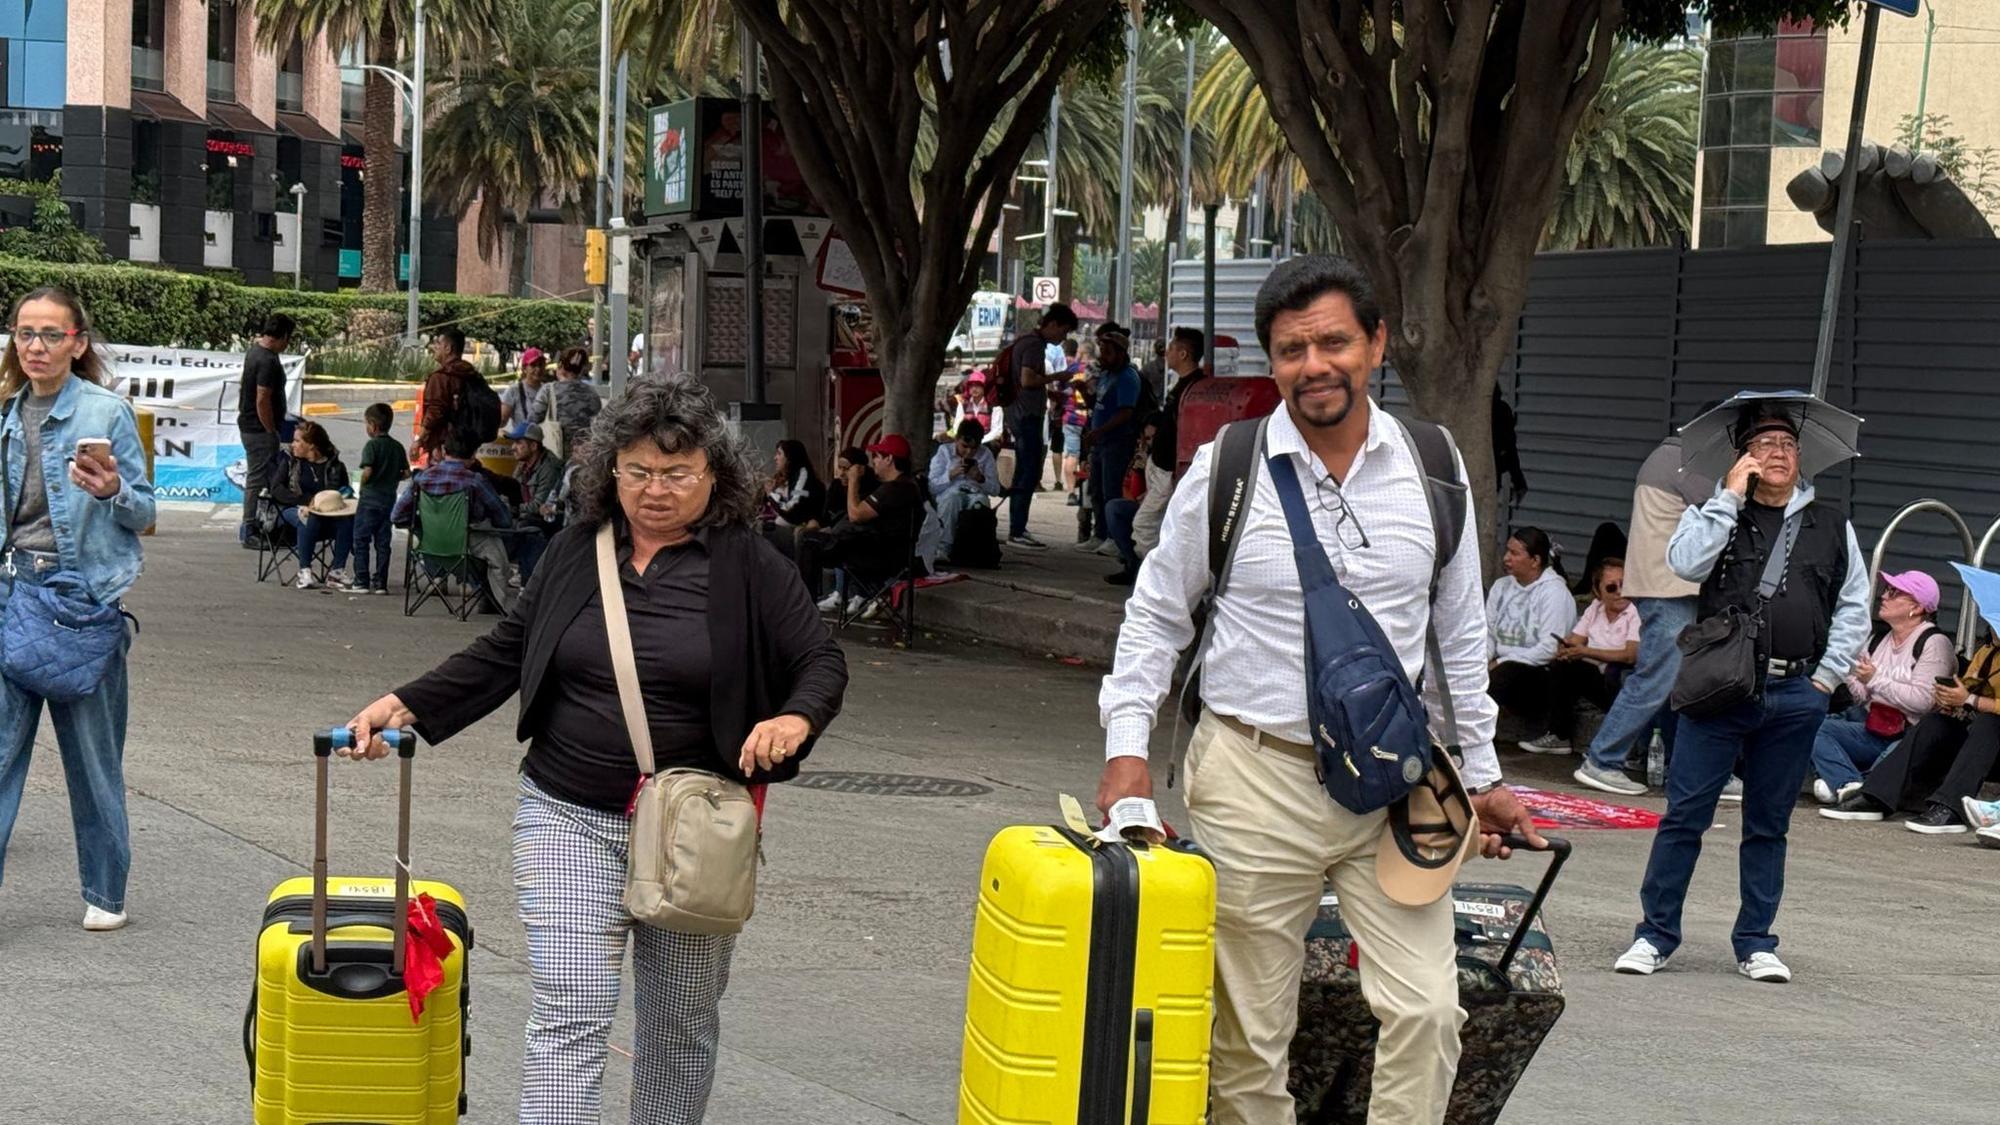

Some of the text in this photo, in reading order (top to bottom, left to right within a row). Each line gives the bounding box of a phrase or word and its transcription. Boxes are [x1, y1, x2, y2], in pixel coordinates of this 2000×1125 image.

[978, 307, 1001, 327] ERUM
[115, 353, 144, 364] de
[151, 355, 174, 367] la
